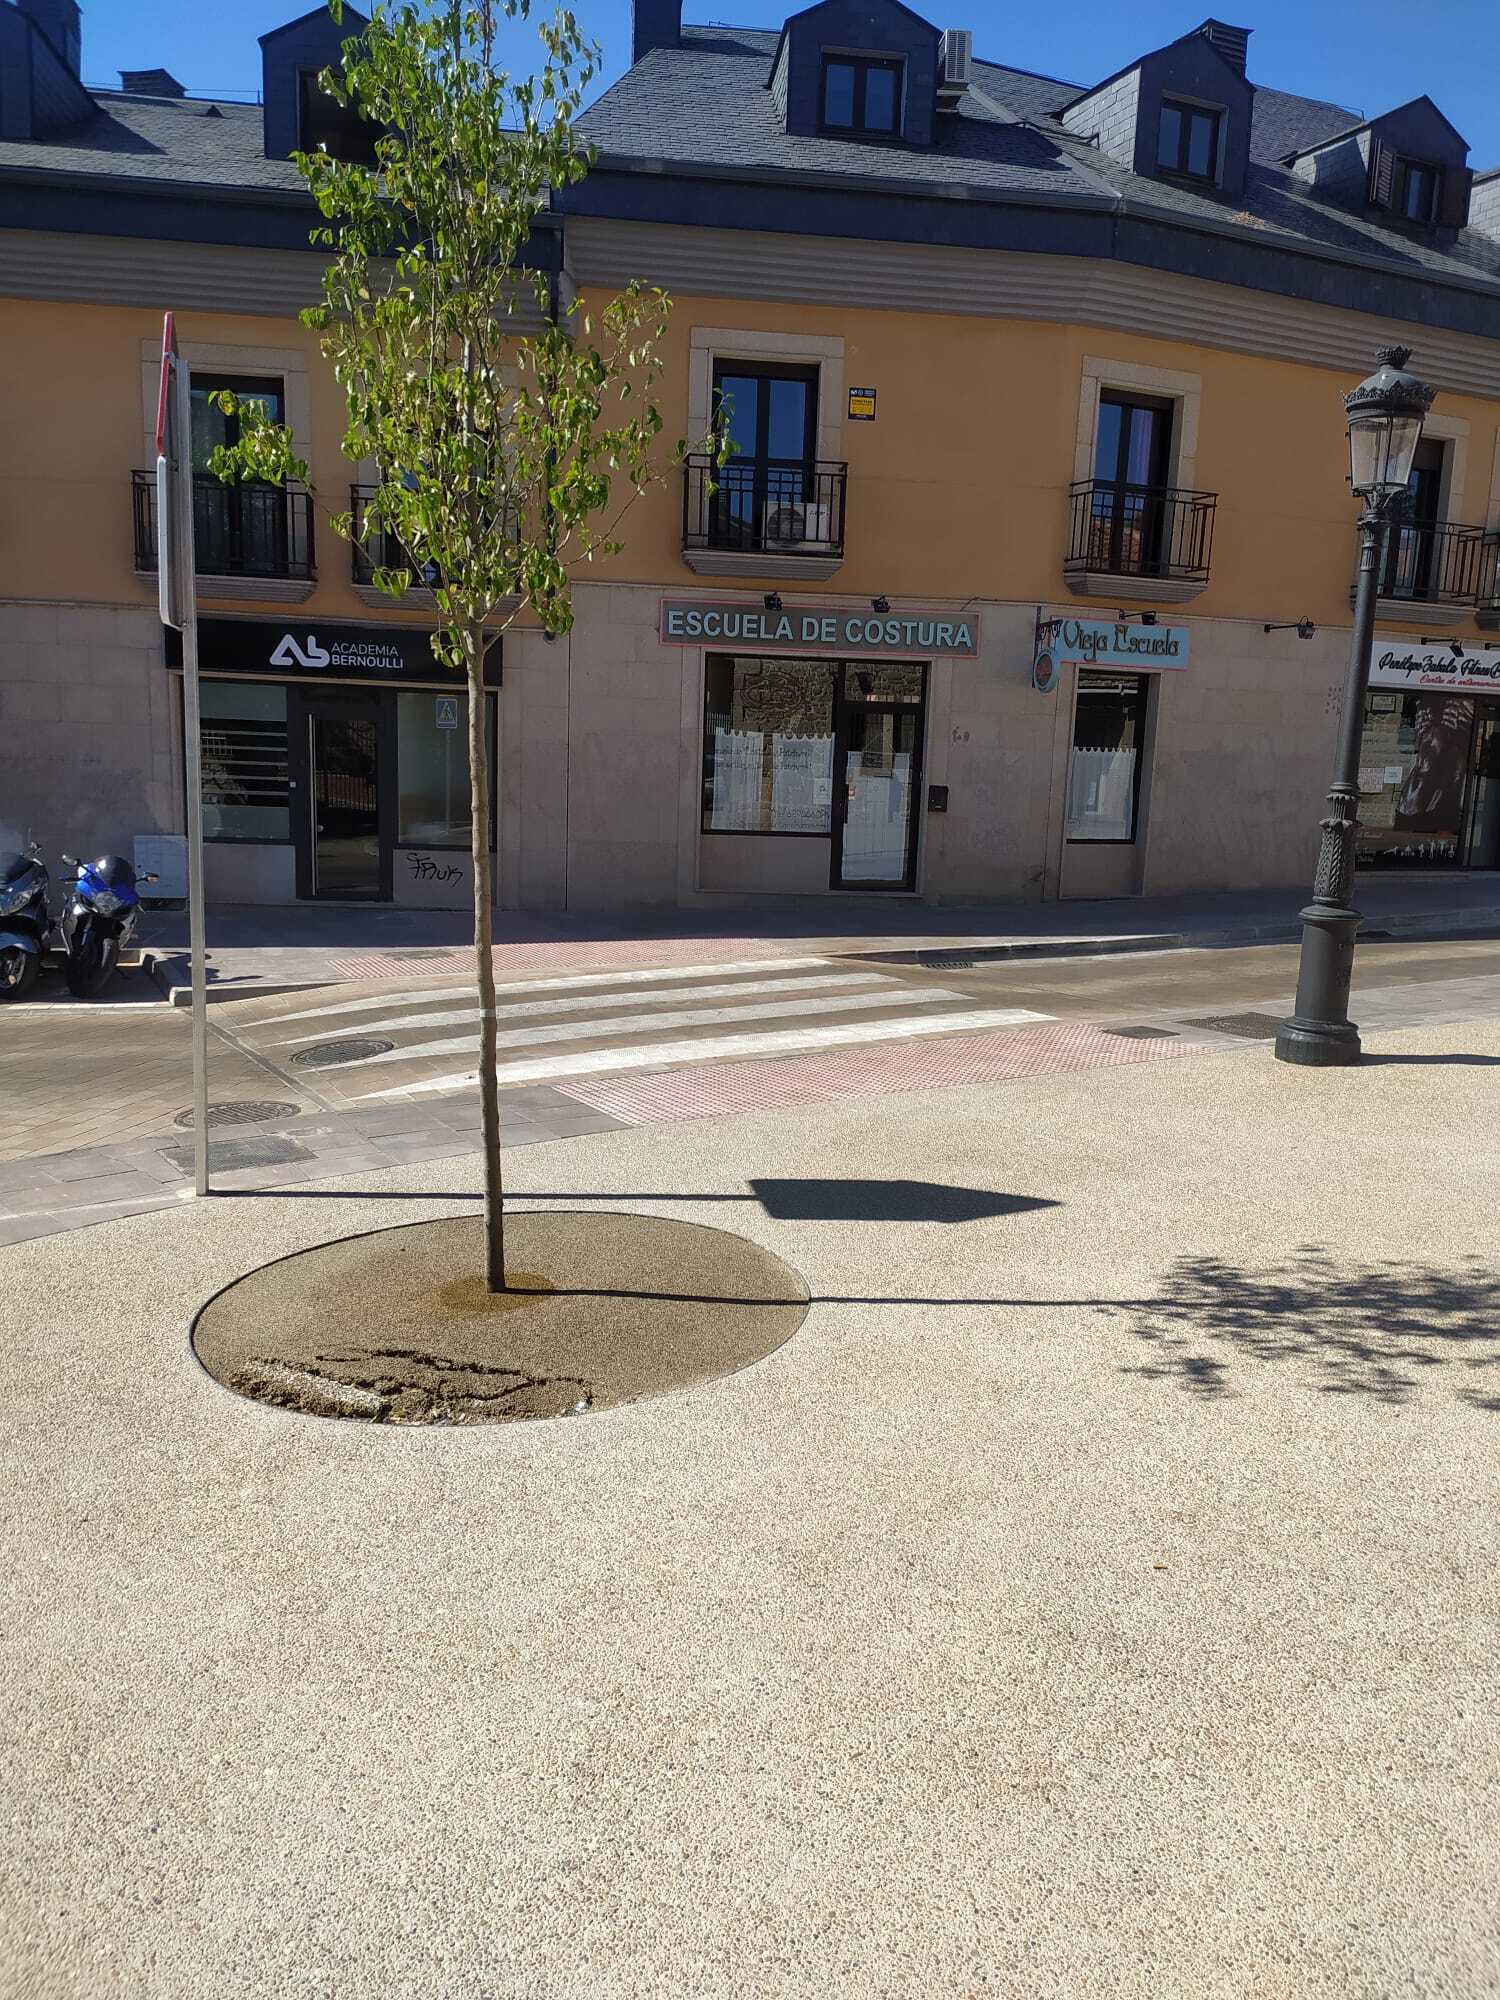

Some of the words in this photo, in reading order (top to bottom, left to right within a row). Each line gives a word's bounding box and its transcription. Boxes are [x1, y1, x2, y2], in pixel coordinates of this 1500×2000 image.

[667, 609, 794, 641] ESCUELA
[801, 616, 837, 643] DE
[845, 618, 973, 649] COSTURA
[1063, 620, 1108, 662] Vieja
[1113, 624, 1179, 657] Escuela
[330, 642, 400, 657] ACADEMIA
[331, 654, 404, 669] BERNOULLI
